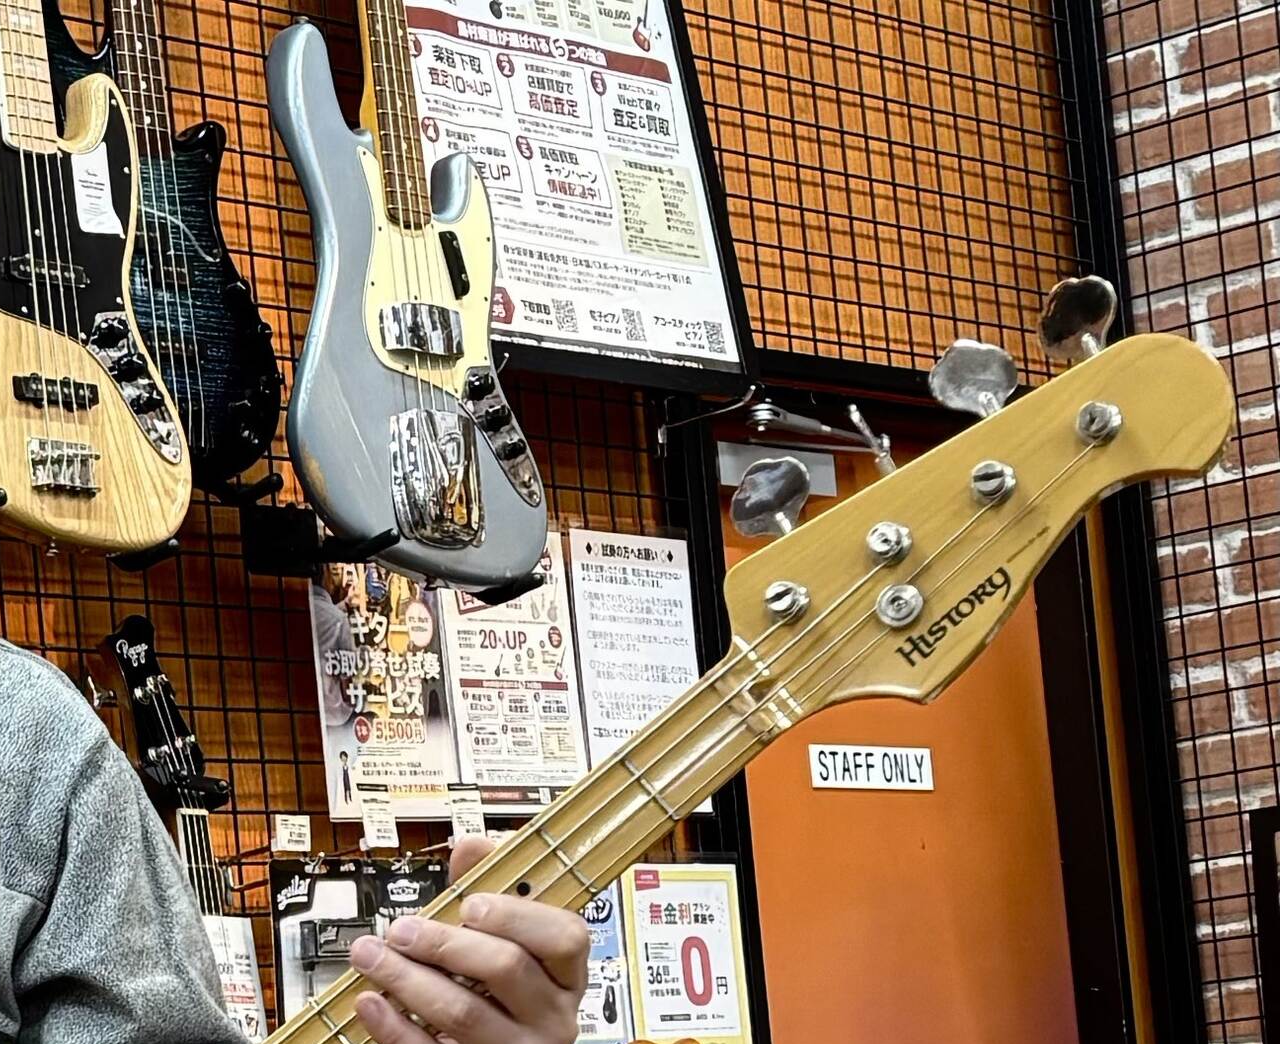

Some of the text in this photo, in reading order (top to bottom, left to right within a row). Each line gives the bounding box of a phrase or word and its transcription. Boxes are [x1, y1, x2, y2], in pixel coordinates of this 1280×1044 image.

[895, 566, 1012, 668] HISTORY
[818, 750, 924, 784] STAFF ONLY
[649, 902, 692, 925] 無金利
[680, 935, 714, 1007] 0
